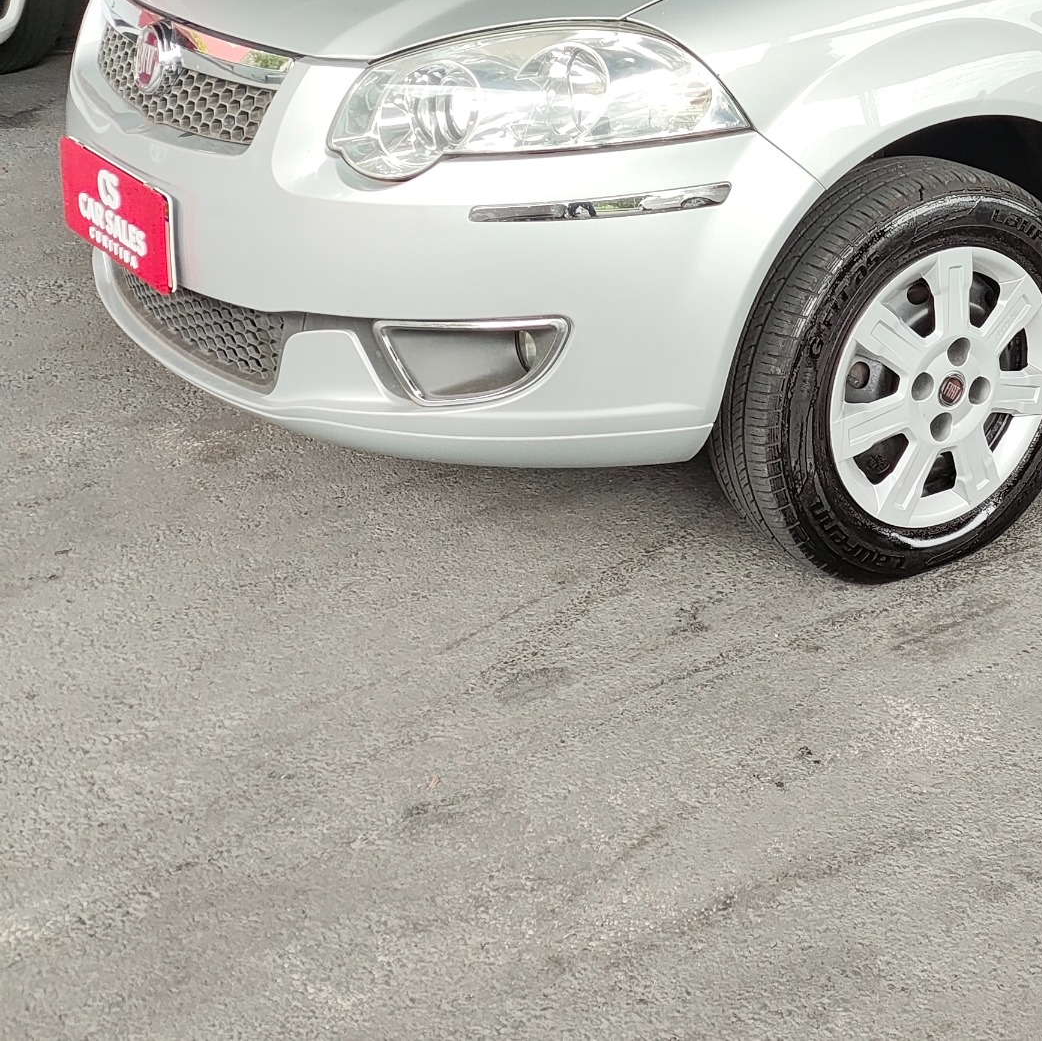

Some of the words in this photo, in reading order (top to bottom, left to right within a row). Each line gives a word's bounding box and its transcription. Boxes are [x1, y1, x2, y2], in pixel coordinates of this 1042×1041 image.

[78, 192, 106, 231] CAR
[105, 210, 148, 257] SALES
[88, 226, 140, 270] CURITIBA
